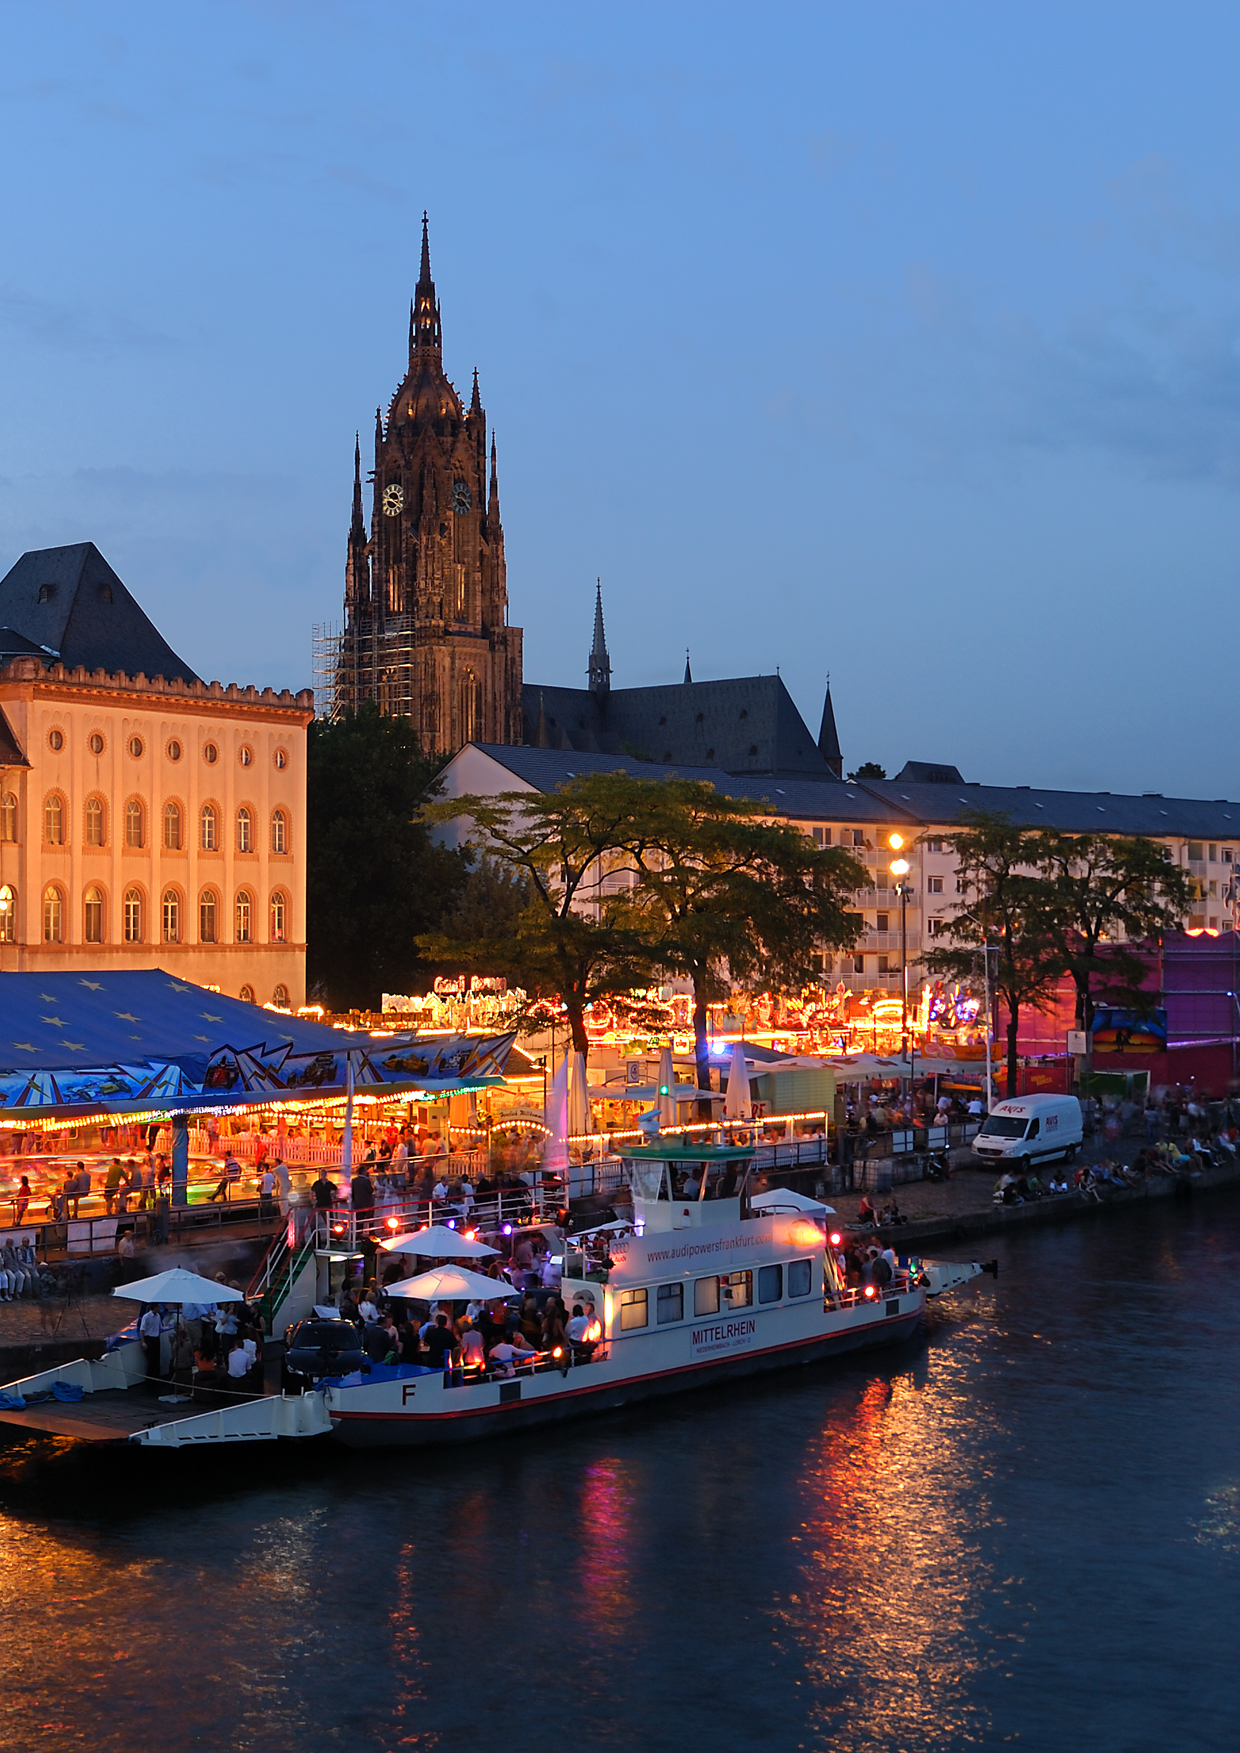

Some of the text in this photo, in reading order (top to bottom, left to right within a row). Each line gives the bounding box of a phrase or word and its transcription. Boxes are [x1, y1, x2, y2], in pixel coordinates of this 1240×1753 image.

[999, 1105, 1026, 1114] AVIS
[1045, 1115, 1058, 1126] AVIS
[647, 1232, 772, 1262] www.audipowersfrankfurt.com
[692, 1320, 756, 1345] MITTELRHEIN
[402, 1384, 416, 1406] F
